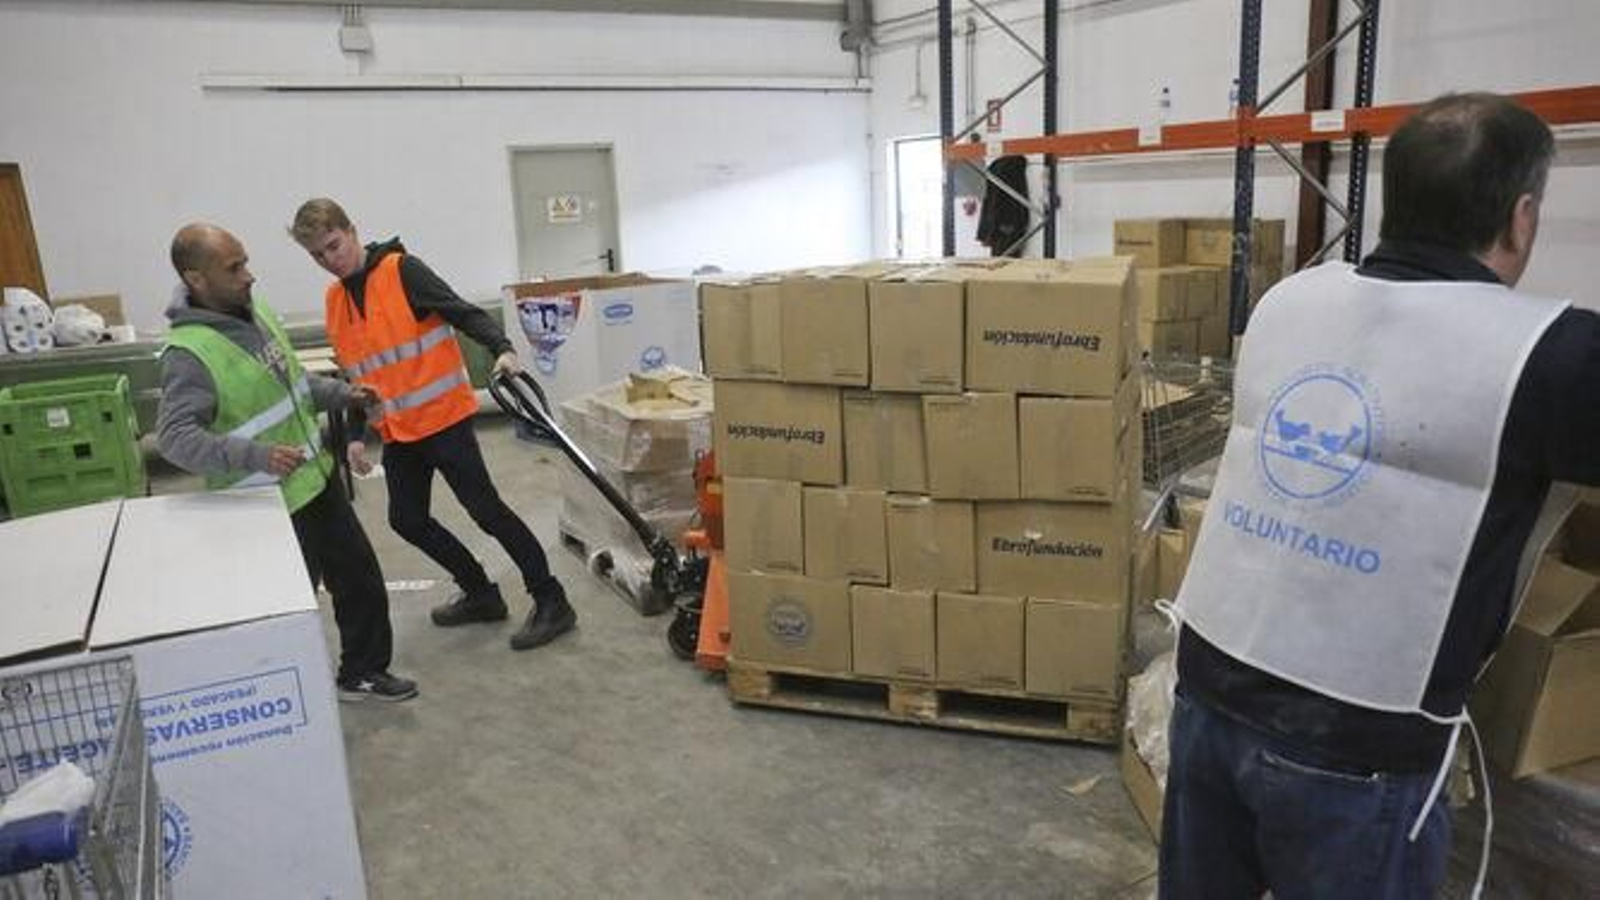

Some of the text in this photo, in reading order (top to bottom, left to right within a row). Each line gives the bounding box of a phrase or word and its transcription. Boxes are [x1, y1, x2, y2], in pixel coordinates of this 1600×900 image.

[982, 329, 1101, 351] Ebrofundación
[727, 423, 825, 445] Ebrofundación
[992, 537, 1103, 559] Ebrofundación
[147, 697, 293, 746] CONSERVAS
